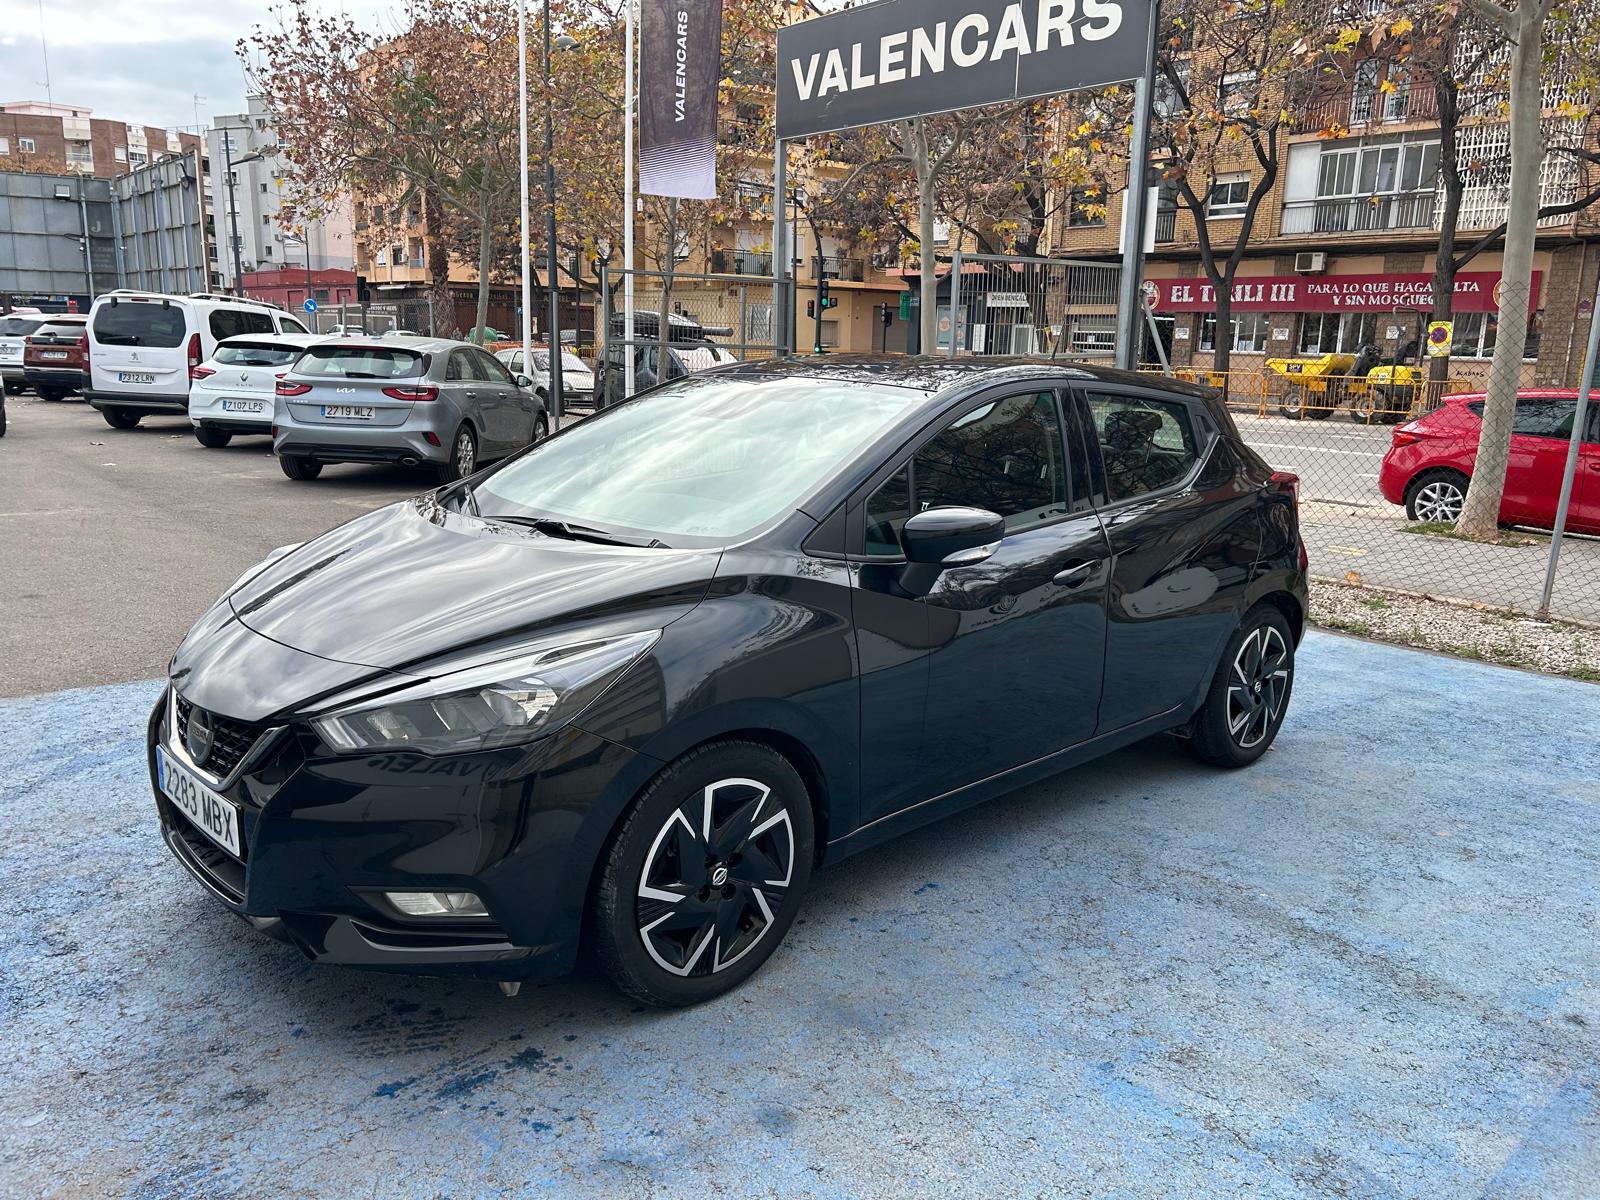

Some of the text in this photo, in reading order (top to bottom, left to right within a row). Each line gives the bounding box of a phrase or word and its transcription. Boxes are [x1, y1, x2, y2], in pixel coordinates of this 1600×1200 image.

[791, 0, 1122, 100] VALENCARS
[675, 10, 688, 122] VALENCARS
[1171, 285, 1194, 303] EL
[1270, 283, 1296, 302] III
[1307, 284, 1339, 294] PARA
[1343, 284, 1359, 294] LO
[1362, 283, 1389, 294] QUE
[1394, 282, 1433, 293] HAGA
[1332, 295, 1343, 306] Y
[1345, 295, 1367, 306] SIN
[122, 372, 155, 382] 7312 LRN
[227, 402, 263, 411] 7107 LPS
[327, 405, 373, 417] 2719 MLZ
[165, 761, 234, 847] 2283 MBX
